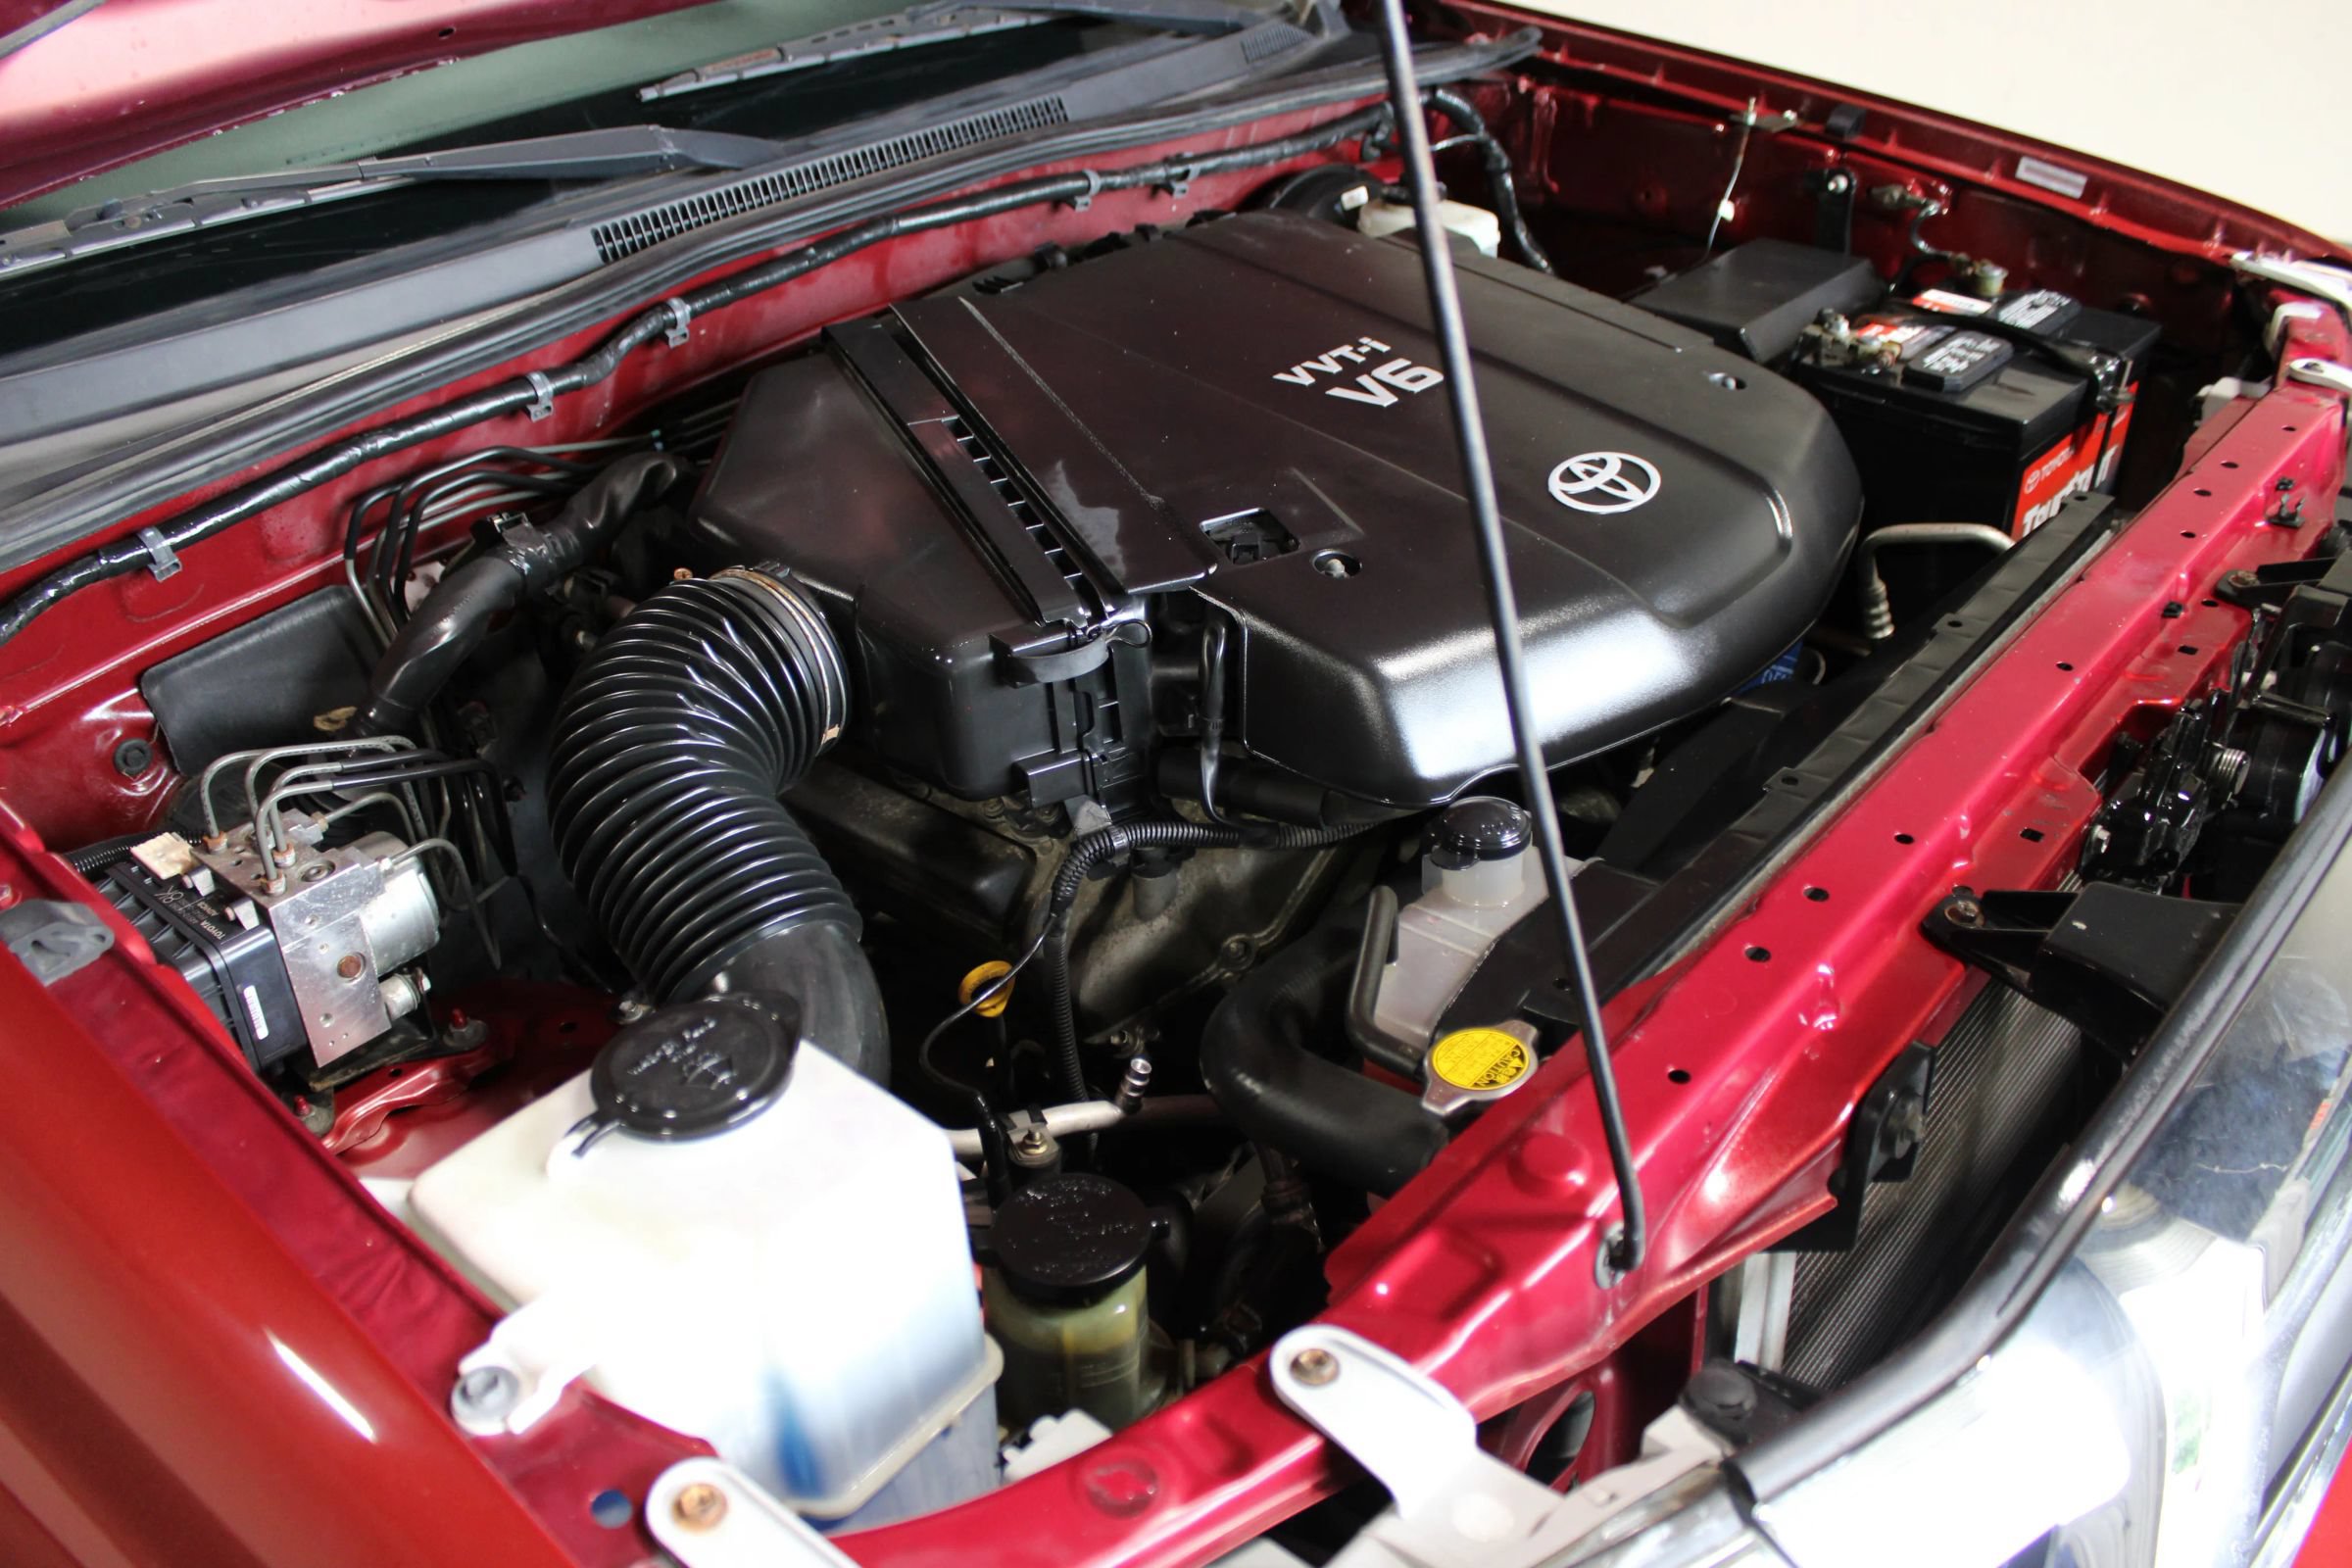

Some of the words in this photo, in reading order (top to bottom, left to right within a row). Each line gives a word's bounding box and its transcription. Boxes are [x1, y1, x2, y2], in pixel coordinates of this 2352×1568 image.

[1272, 336, 1392, 386] VVT-i
[1325, 358, 1445, 408] V6
[200, 921, 226, 941] TOYOTA
[1473, 1049, 1521, 1087] CAUTION
